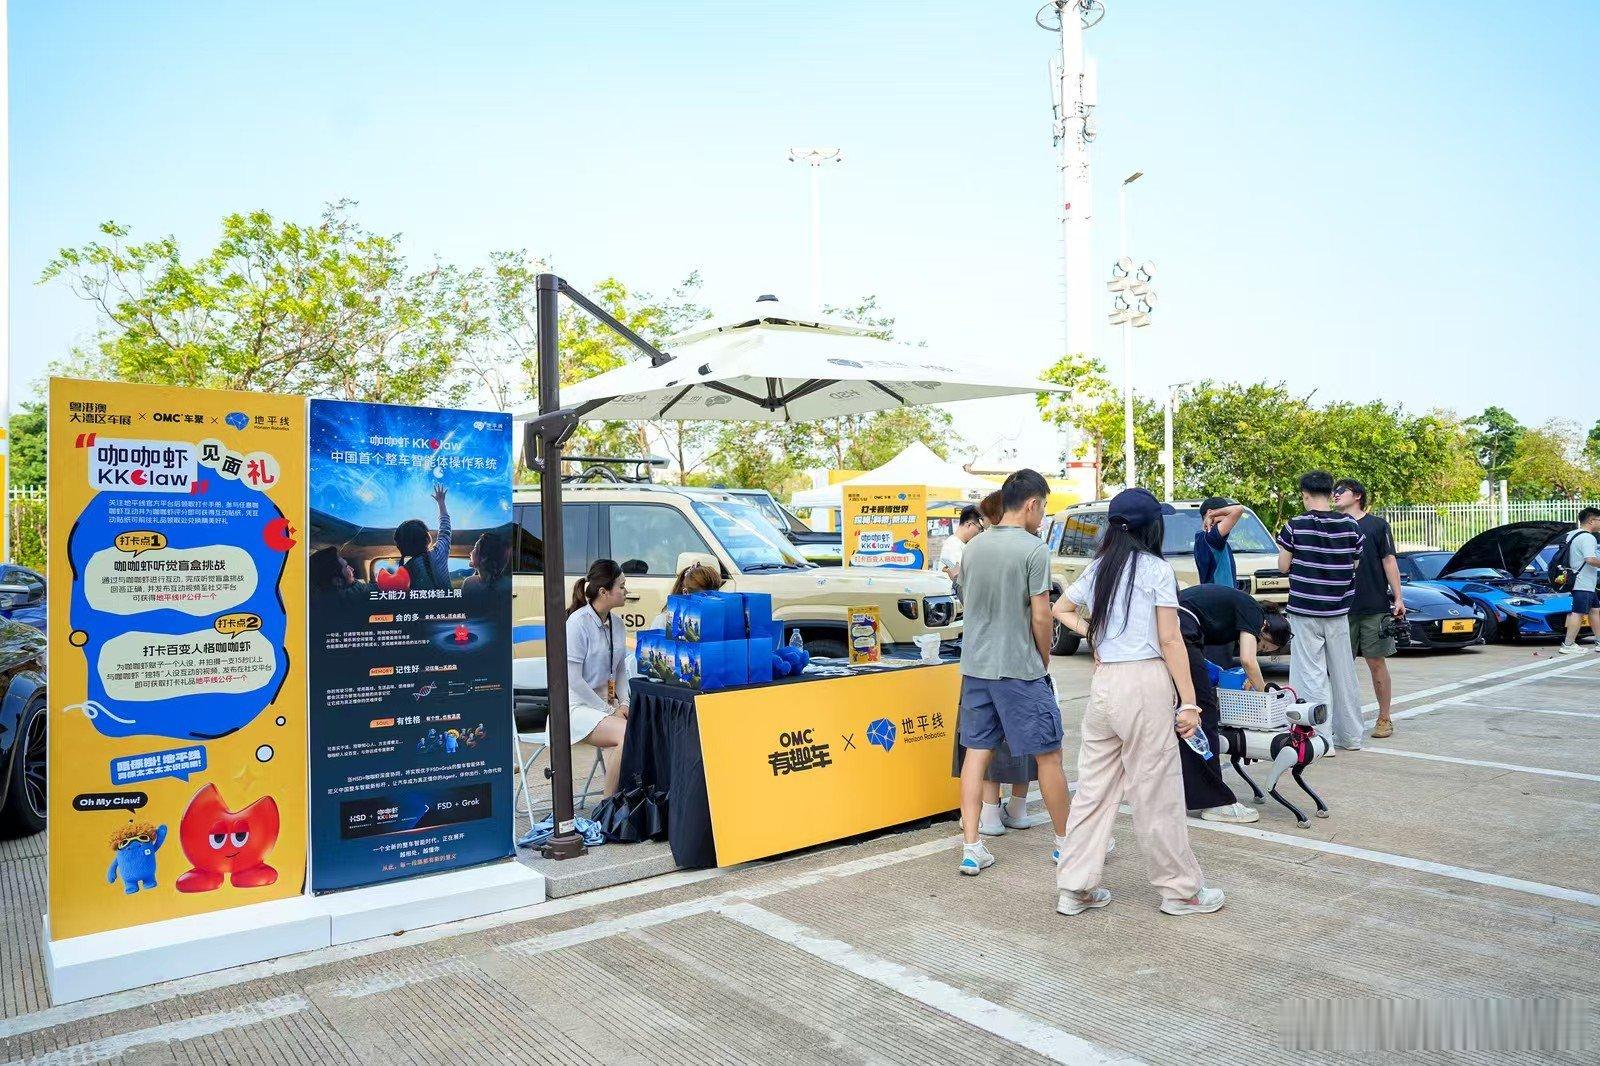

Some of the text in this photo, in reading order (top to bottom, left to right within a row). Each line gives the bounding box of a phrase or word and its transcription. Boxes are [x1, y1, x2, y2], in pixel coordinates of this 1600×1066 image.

[69, 402, 107, 414] 粤港澳
[69, 413, 132, 426] 大湾区车展
[184, 414, 204, 425] 车聚
[254, 415, 290, 427] 地平线
[369, 435, 410, 446] 咖咖虾
[97, 444, 189, 469] 咖咖虾
[331, 450, 498, 470] 中国首个整车智能体操作系统
[202, 443, 275, 485] 见面礼
[119, 534, 161, 548] 打卡点1
[861, 533, 890, 542] 咖咖虾
[114, 559, 226, 572] 咖咖虾听觉盲盒挑战
[369, 589, 462, 601] 三大能力 拓宽体验上限
[218, 616, 259, 629] 打卡点2
[395, 614, 420, 622] 会的多
[621, 614, 646, 628] SD
[143, 641, 252, 657] 打卡百变人格咖咖虾
[395, 665, 420, 674] 记性好
[397, 716, 421, 726] 有性格
[901, 712, 944, 735] 地平线
[779, 729, 815, 748] OMC
[903, 730, 947, 745] Horizon Robotics
[768, 744, 833, 776] 有趣车
[79, 796, 141, 808] Oh My Claw!
[437, 801, 453, 810] FSD
[461, 798, 480, 807] Grok
[349, 814, 367, 823] HSD
